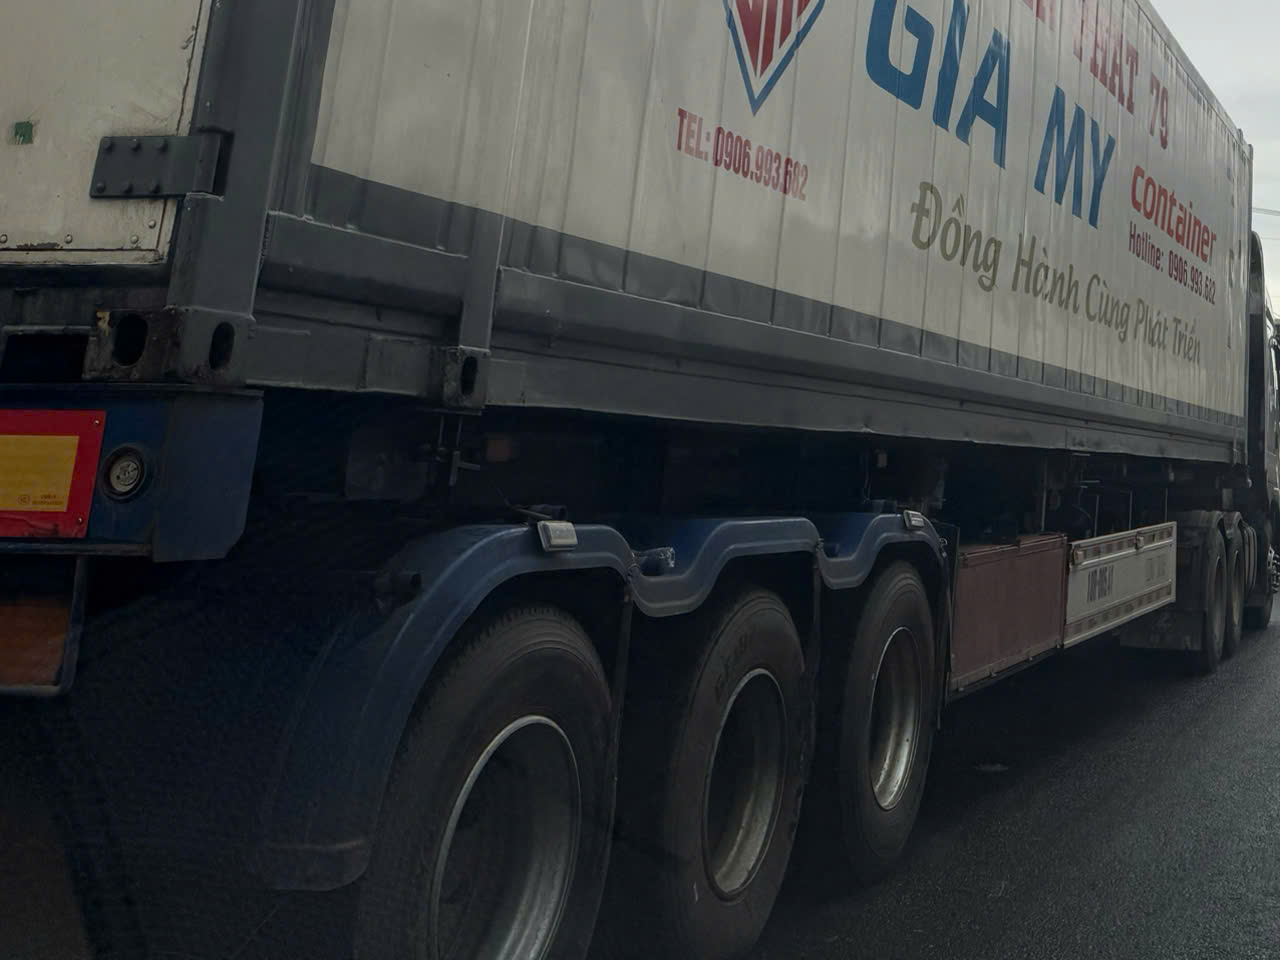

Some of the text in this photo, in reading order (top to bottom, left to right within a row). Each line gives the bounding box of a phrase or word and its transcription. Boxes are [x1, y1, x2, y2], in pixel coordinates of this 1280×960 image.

[1034, 85, 1116, 229] MY
[1150, 72, 1168, 150] 79
[911, 181, 1002, 292] Đồng
[1012, 232, 1080, 315] Hành
[1085, 273, 1131, 343] Cùng
[1128, 221, 1164, 273] Hotline:
[1131, 165, 1217, 265] container
